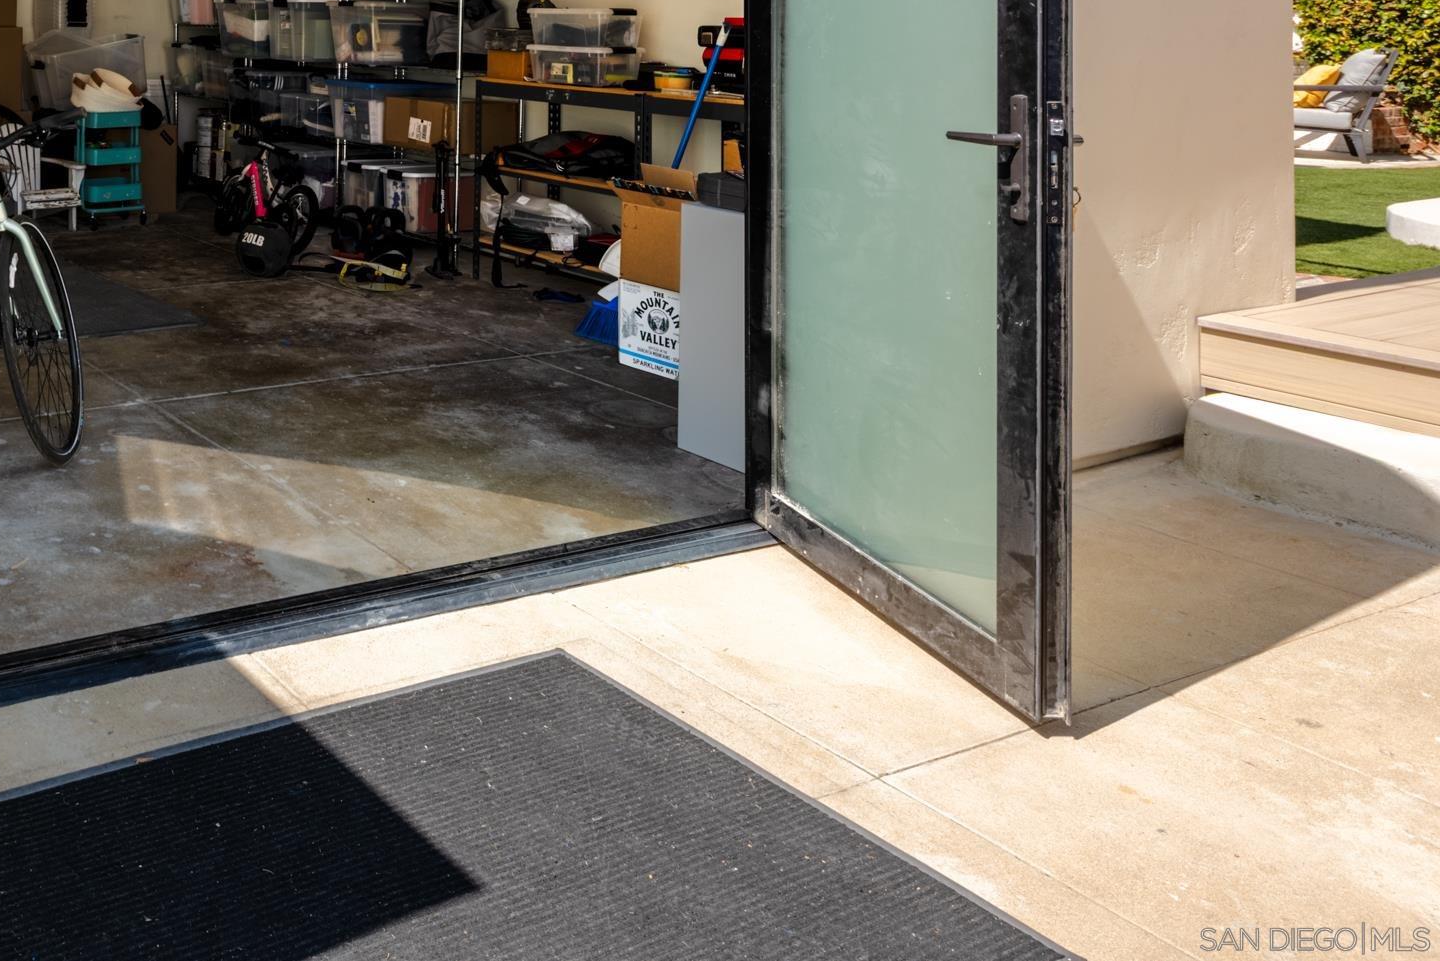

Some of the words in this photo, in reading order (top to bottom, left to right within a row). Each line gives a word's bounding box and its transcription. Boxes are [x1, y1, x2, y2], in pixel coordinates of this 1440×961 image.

[241, 231, 266, 247] 20LB
[653, 290, 665, 298] THE
[640, 330, 677, 350] VALLEY
[632, 357, 664, 373] SPARKLING
